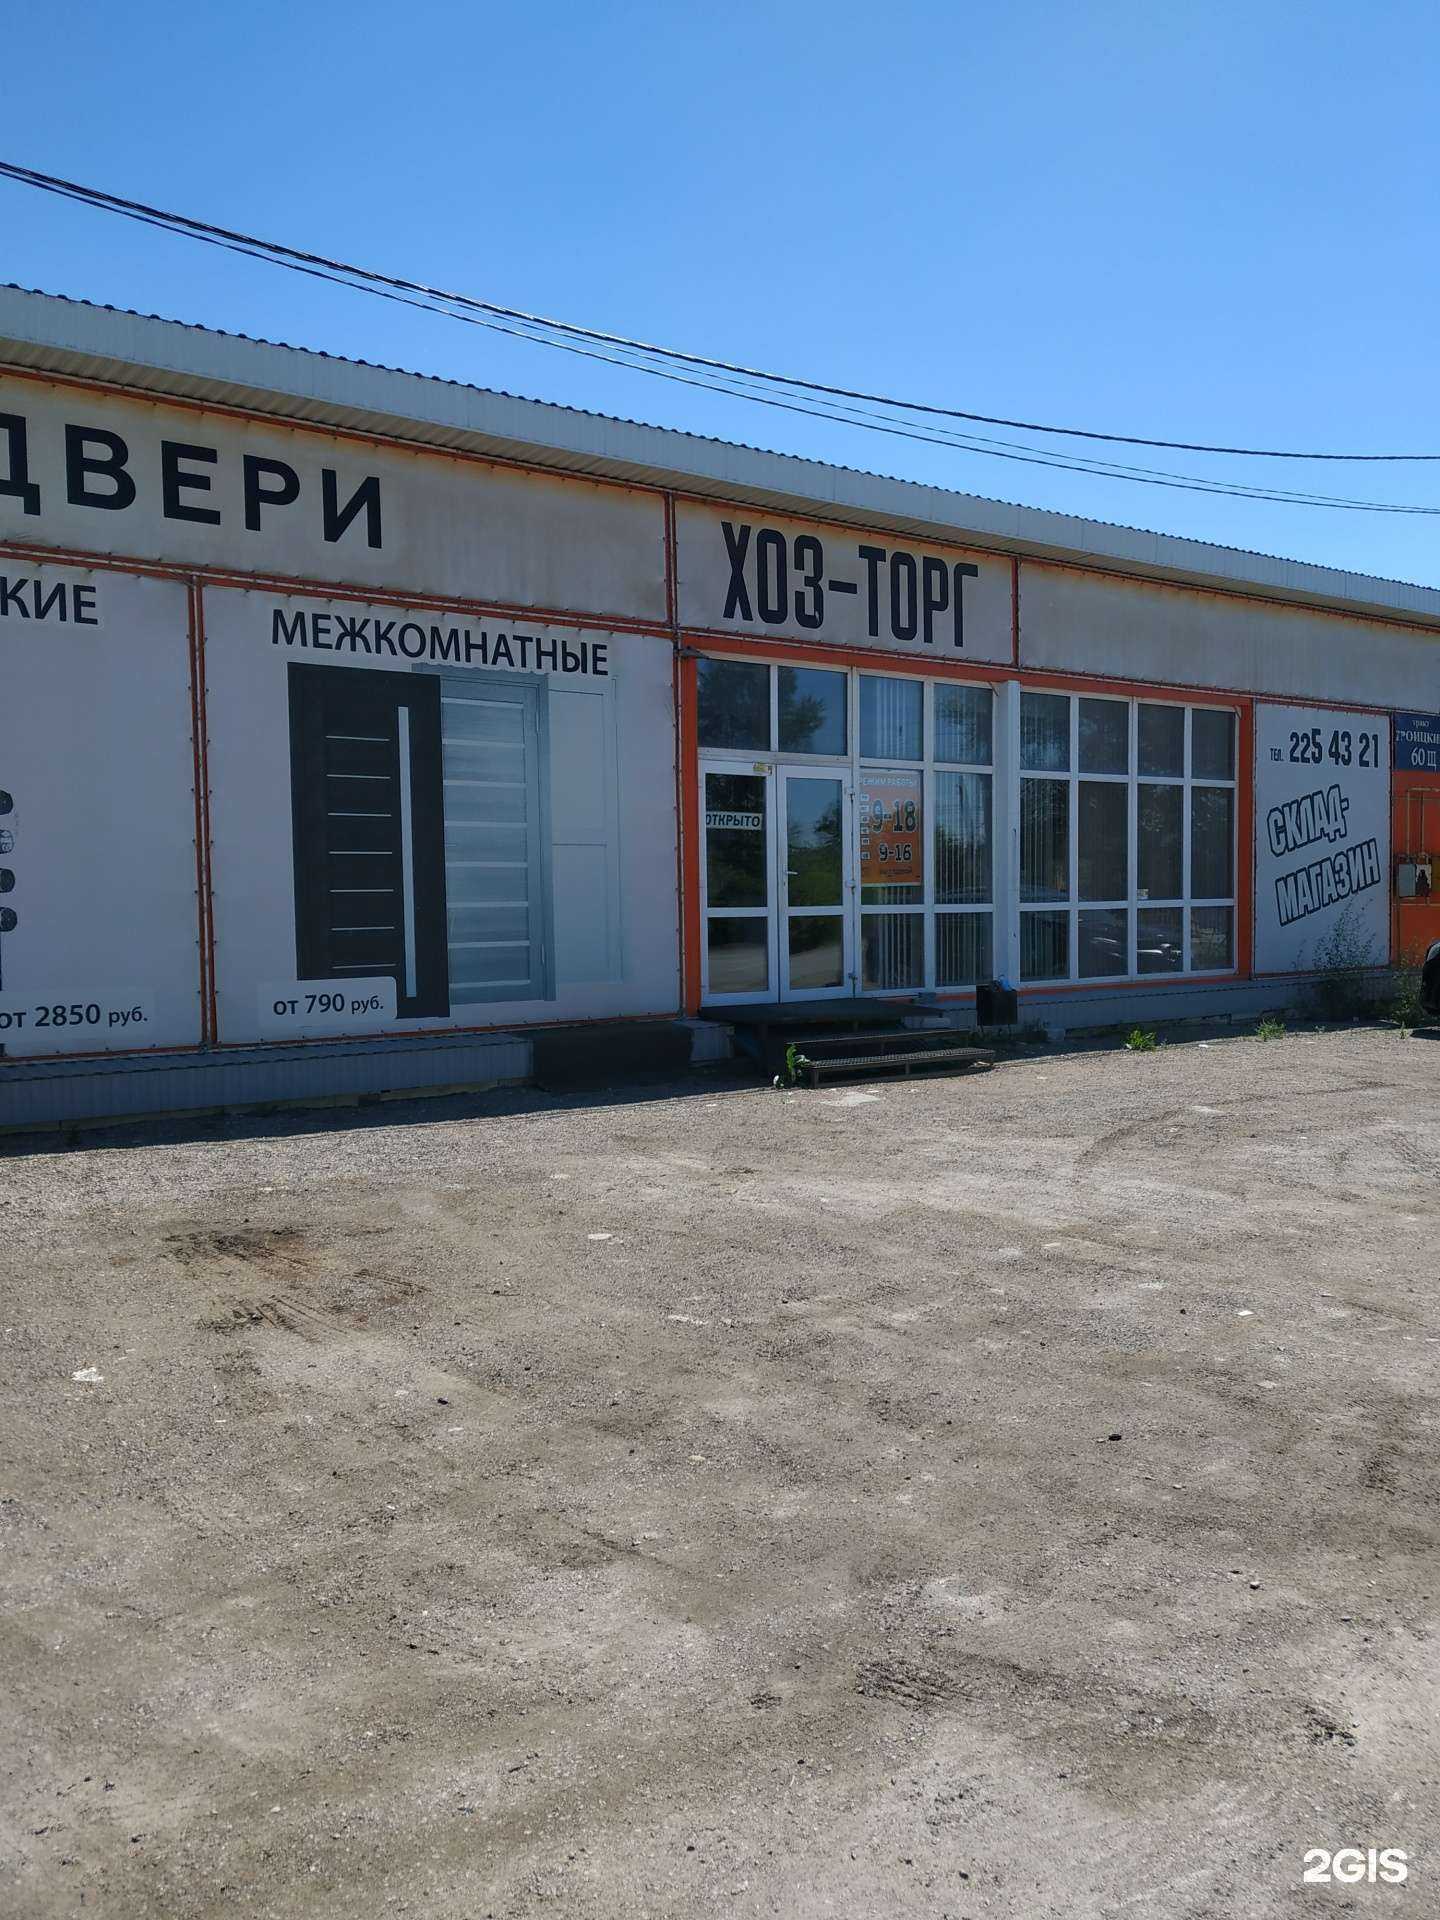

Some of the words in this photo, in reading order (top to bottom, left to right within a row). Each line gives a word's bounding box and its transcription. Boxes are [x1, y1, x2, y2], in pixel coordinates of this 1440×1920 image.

[0, 576, 98, 625] КИЕ
[721, 521, 978, 647] ХОЗ-ТОРГ
[272, 609, 608, 676] МЕЖКОМНАТНЫЕ
[1289, 728, 1322, 764] 225
[1328, 730, 1352, 766] 43
[1359, 732, 1379, 768] 21
[706, 813, 760, 827] ОТКРЫТО
[1267, 784, 1349, 857] СКЛАД-
[1274, 838, 1381, 927] МАГАЗИН
[35, 1003, 100, 1027] 2850
[108, 1006, 148, 1027] руб.
[273, 1000, 298, 1015] от
[305, 993, 345, 1014] 790
[351, 995, 384, 1014] руб.
